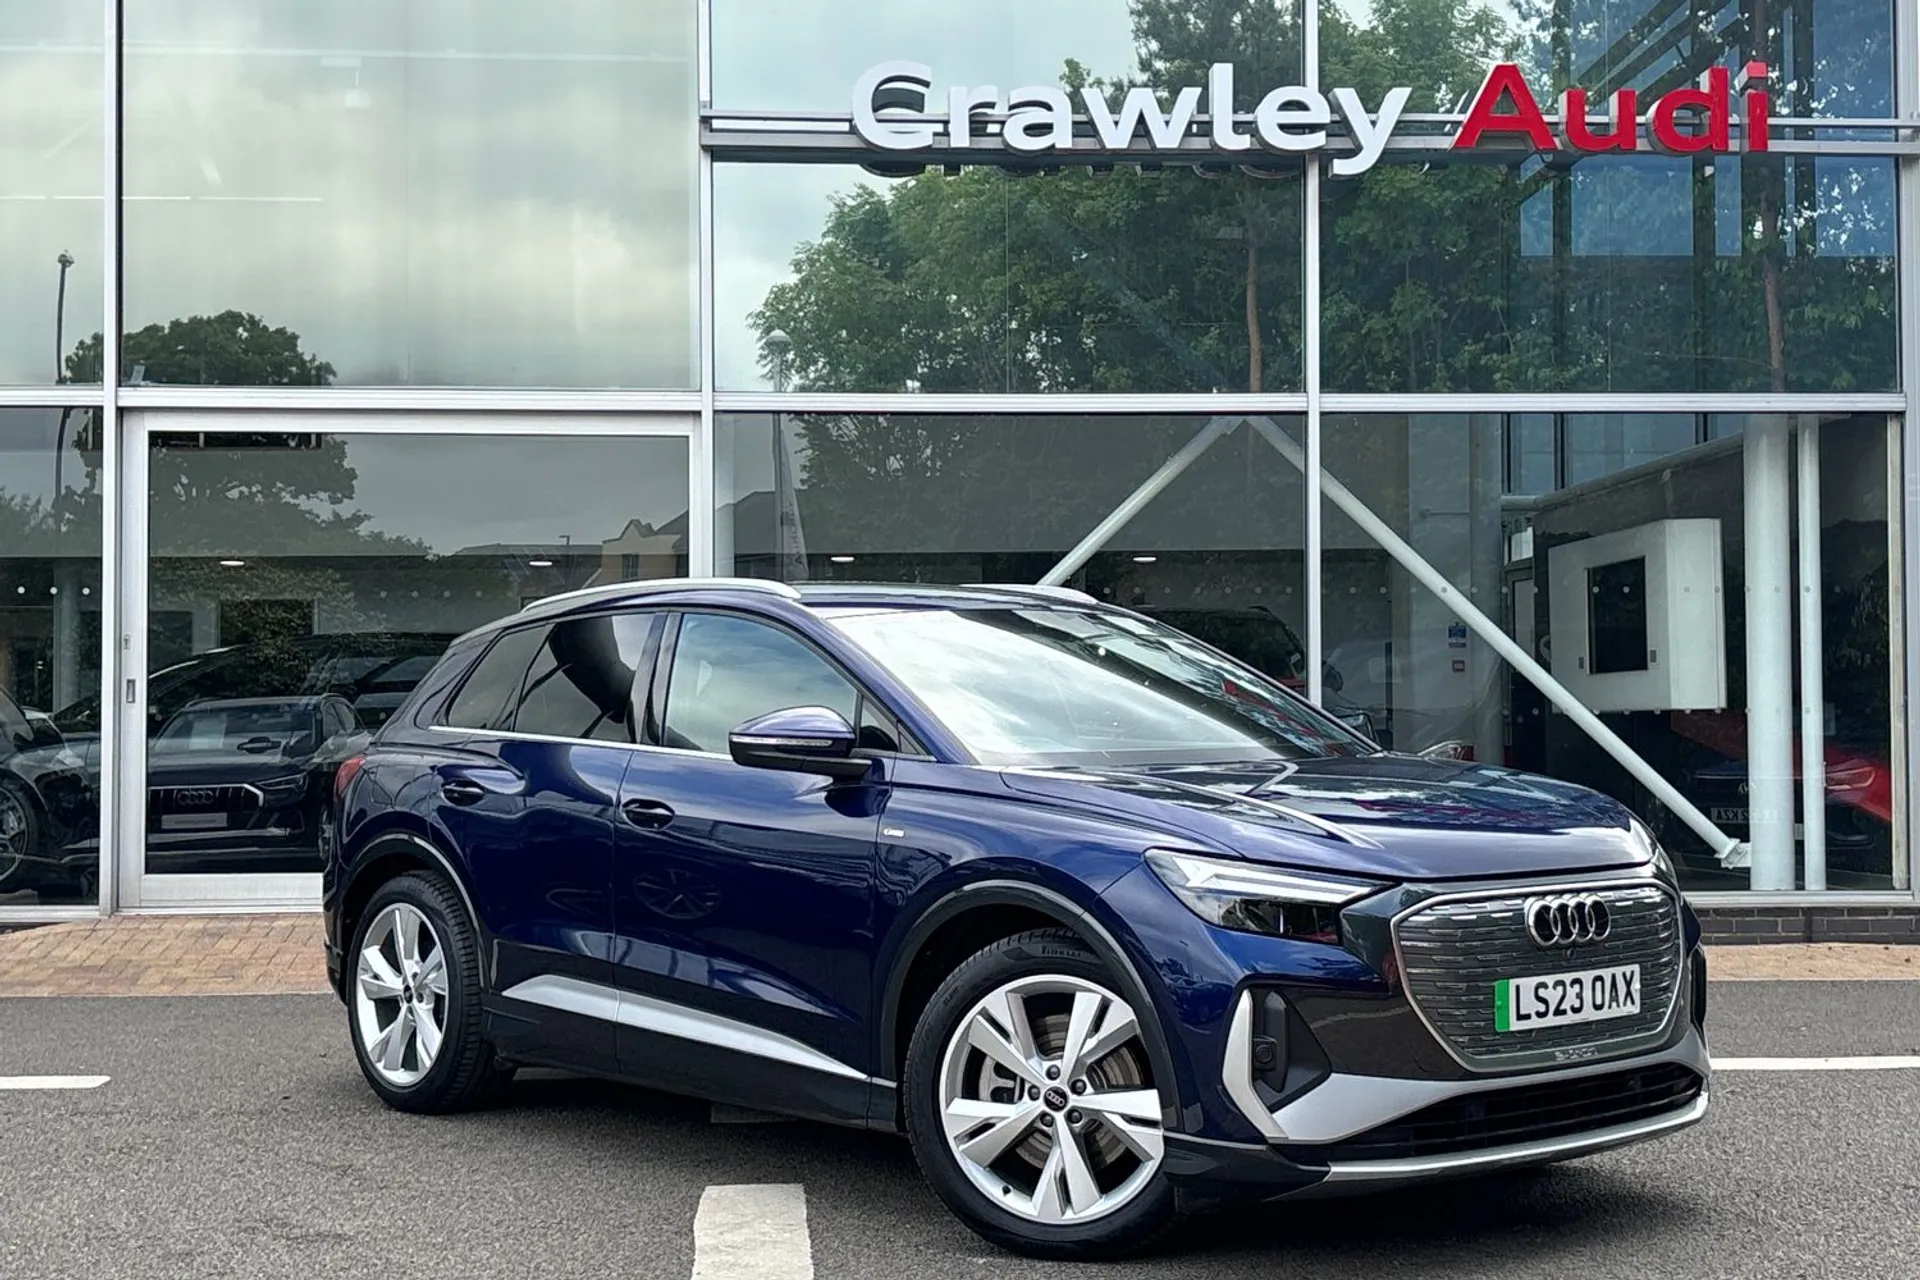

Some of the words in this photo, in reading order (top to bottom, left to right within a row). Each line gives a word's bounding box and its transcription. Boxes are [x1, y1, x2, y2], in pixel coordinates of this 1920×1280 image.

[852, 60, 1412, 177] Crawley
[1450, 61, 1769, 153] Audi
[1515, 977, 1584, 1021] LS23
[1591, 970, 1636, 1011] OAX
